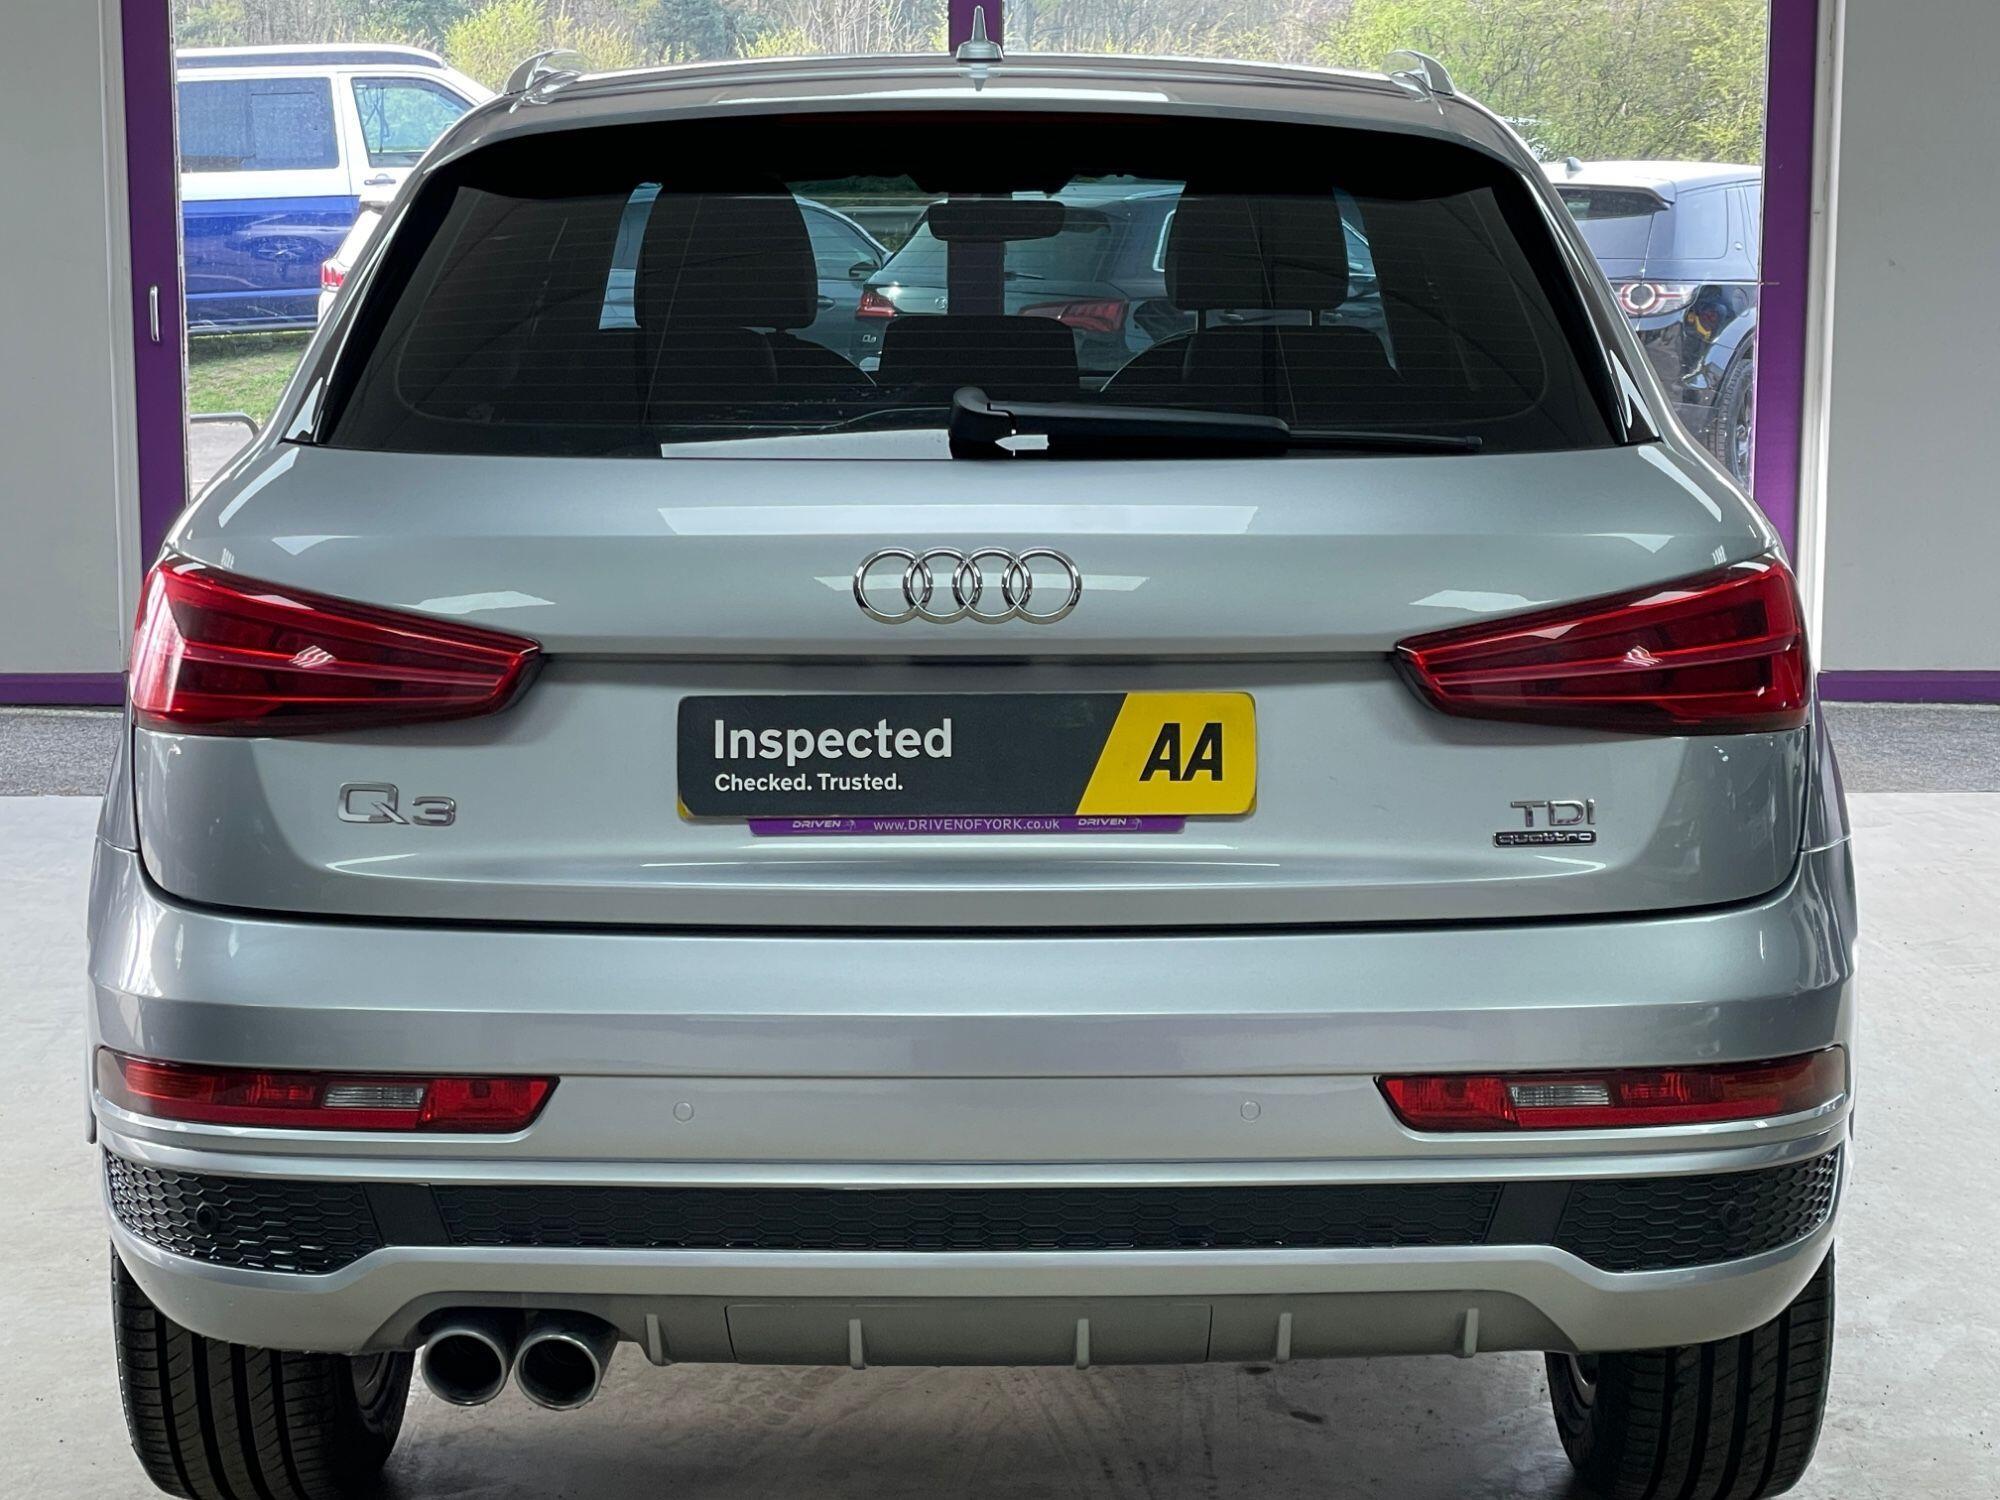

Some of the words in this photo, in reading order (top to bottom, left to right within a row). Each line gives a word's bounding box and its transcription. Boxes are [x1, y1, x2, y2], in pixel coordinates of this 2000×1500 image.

[714, 718, 953, 767] Inspected
[1138, 722, 1223, 782] AA
[714, 773, 813, 792] Checked.
[817, 772, 904, 791] Trusted.
[338, 782, 457, 827] Q3
[1510, 798, 1596, 828] TDI
[792, 819, 841, 829] DRIVEN
[873, 818, 1060, 831] www.DRIVENOFYORK.co.uk
[1078, 817, 1127, 827] DRIVEN
[1498, 832, 1592, 845] quattro
